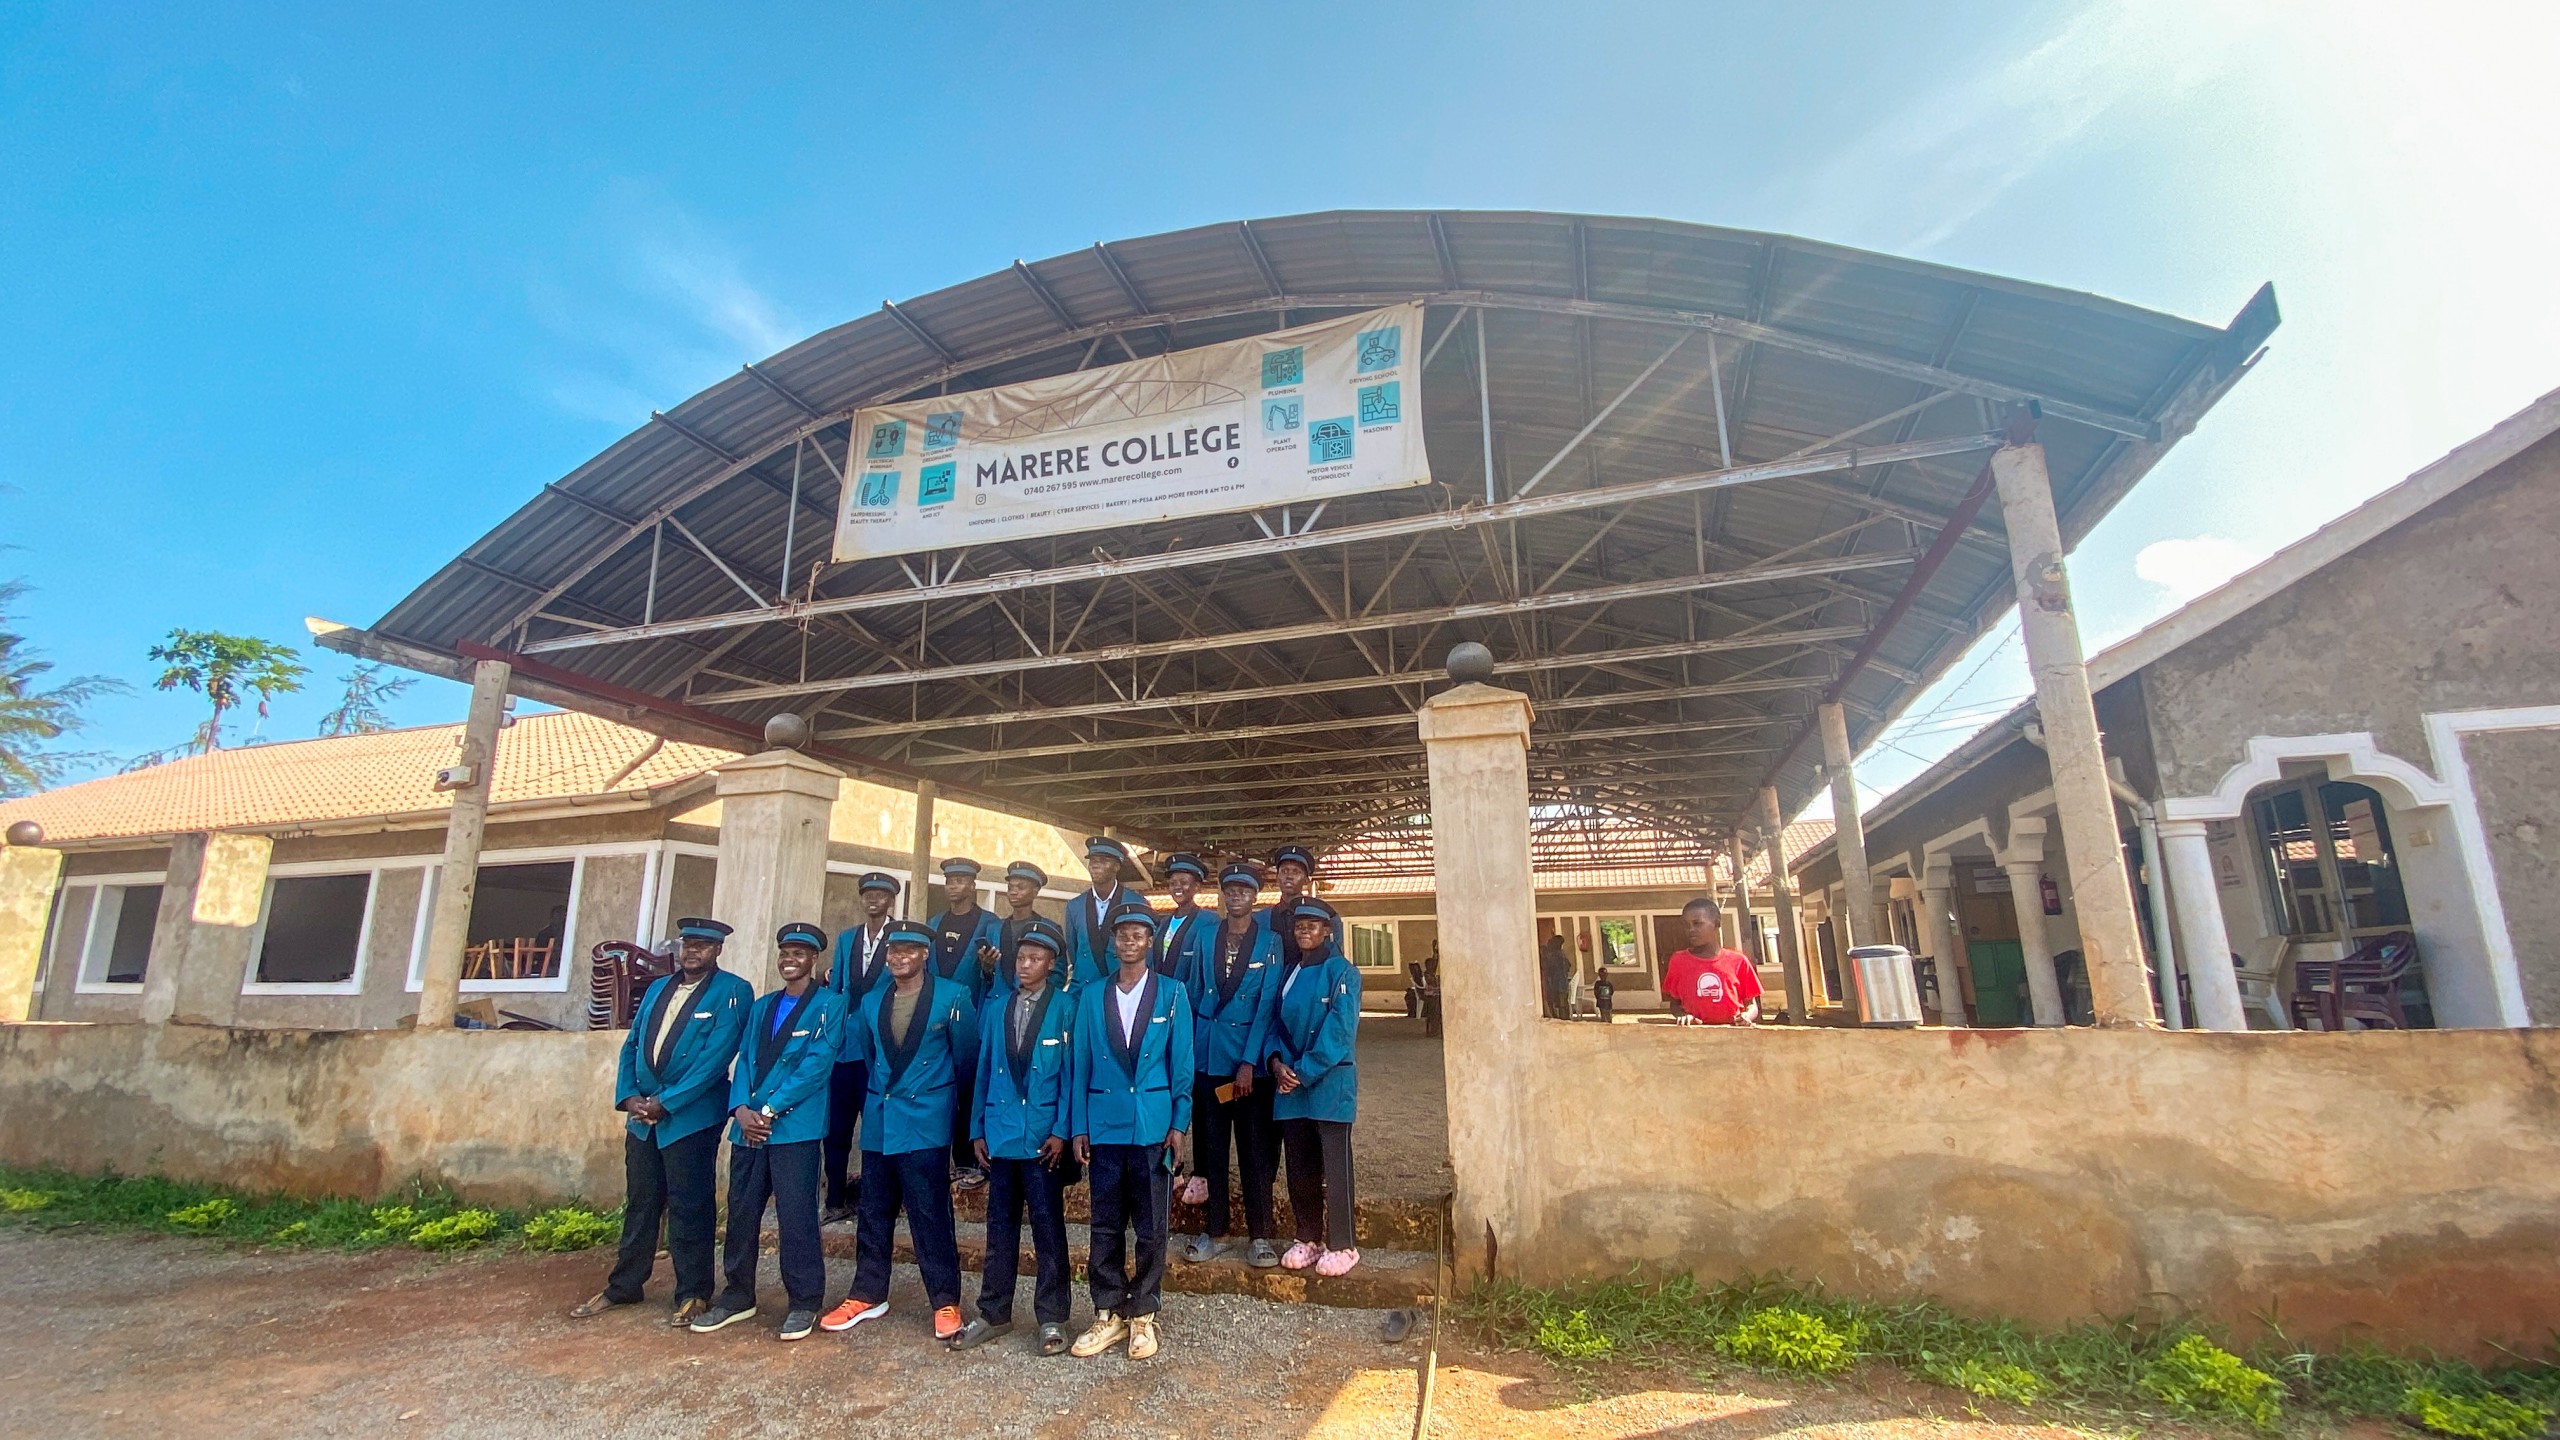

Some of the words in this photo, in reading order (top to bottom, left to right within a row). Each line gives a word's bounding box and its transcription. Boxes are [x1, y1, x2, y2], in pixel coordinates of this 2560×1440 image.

[1374, 370, 1398, 381] SCHOOL
[1267, 387, 1297, 396] PLUMBING
[1363, 425, 1393, 434] MASONRY
[1266, 444, 1297, 453] OPERATOR
[976, 445, 1090, 487] MARERE
[1101, 423, 1240, 467] COLLEGE
[1307, 466, 1329, 474] MOTOR
[1024, 486, 1045, 495] 0740
[1046, 483, 1061, 493] 267
[1062, 481, 1078, 490] 595
[1079, 467, 1182, 487] www.marerecollege.com
[1311, 472, 1351, 481] TECHNOLOGY
[1001, 514, 1025, 522] CLOTHES
[1030, 510, 1051, 518] BEAUTY
[1057, 507, 1074, 515] CYBER
[1075, 503, 1100, 512] SERVICES
[1106, 500, 1127, 508] BAKERY
[1131, 496, 1153, 504] M-PESA
[1168, 491, 1186, 499] MORE
[1186, 489, 1204, 497] FROM
[1209, 486, 1219, 494] AM
[920, 505, 944, 513] COMPUTER
